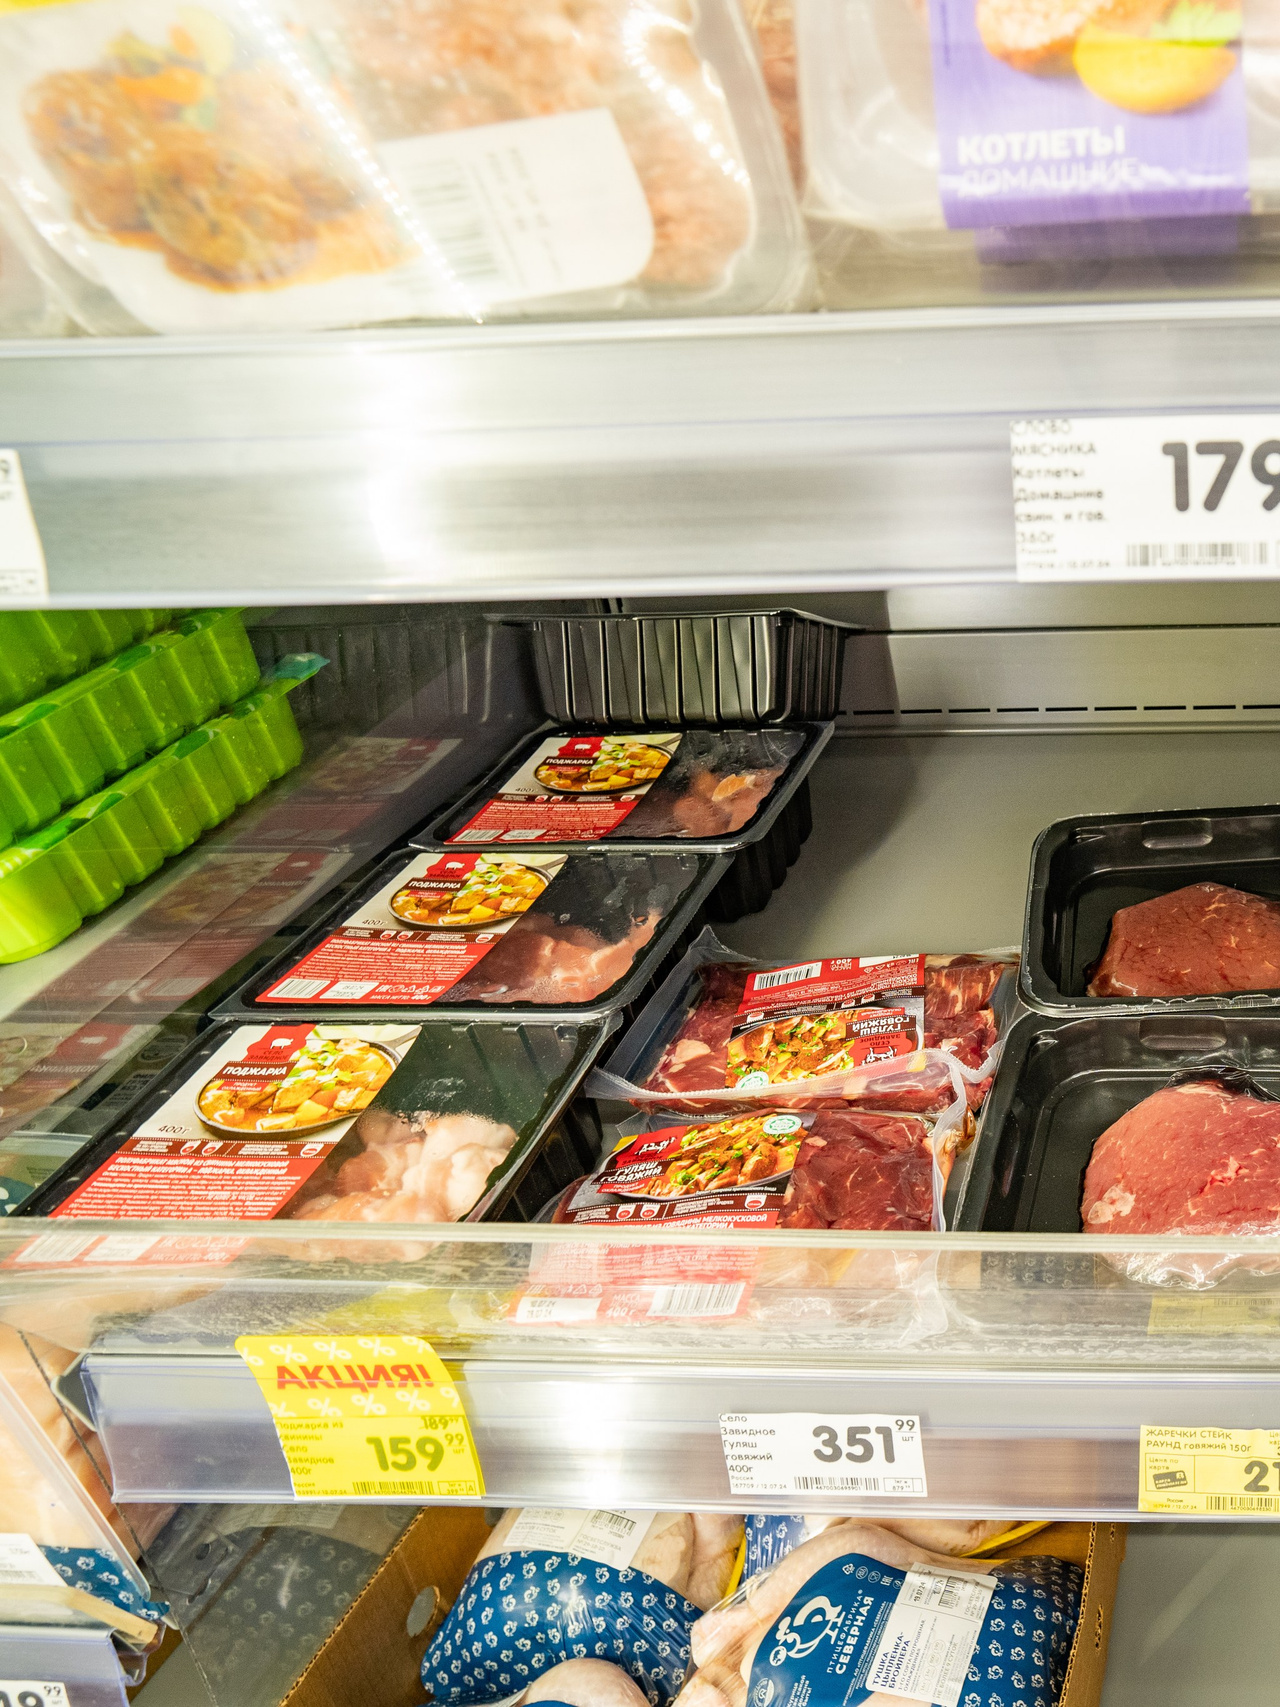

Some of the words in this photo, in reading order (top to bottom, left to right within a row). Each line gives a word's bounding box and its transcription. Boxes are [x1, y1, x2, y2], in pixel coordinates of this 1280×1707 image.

[958, 125, 1125, 165] КОТЛЕТЫ
[408, 880, 461, 889] ПОДЖАРКА
[361, 918, 387, 926] 400г
[852, 1017, 910, 1031] ГОВЯЖИЙ
[860, 1024, 901, 1036] ГУЛЯШ
[222, 1065, 288, 1076] ПОДЖАРКА
[158, 1124, 190, 1134] 400г
[600, 1168, 663, 1182] ГОВЯЖИЙ
[615, 1162, 658, 1176] ГУЛЯШ
[702, 1213, 767, 1223] МЕЛКОКУСКОВОЙ
[276, 1365, 434, 1393] АКЦИЯ!
[719, 1414, 747, 1423] Село
[895, 1419, 915, 1431] 99
[721, 1427, 776, 1436] Завидное
[1146, 1429, 1197, 1438] ЖАРЕЧКИ
[1200, 1430, 1232, 1440] СТЕЙК
[445, 1433, 464, 1446] 99
[723, 1440, 757, 1449] Гуляш
[812, 1425, 895, 1463] 351
[1147, 1440, 1182, 1450] РАУНД
[1230, 1444, 1252, 1452] 150г
[366, 1436, 445, 1472] 159
[726, 1452, 773, 1461] говяжий
[729, 1465, 753, 1473] 400г
[835, 1596, 875, 1675] СЕВЕРНАЯ
[880, 1631, 904, 1687] ЦЫПЛЕНКА-
[889, 1640, 911, 1689] БРОЙЛЕРА
[872, 1651, 890, 1685] ТУШКА
